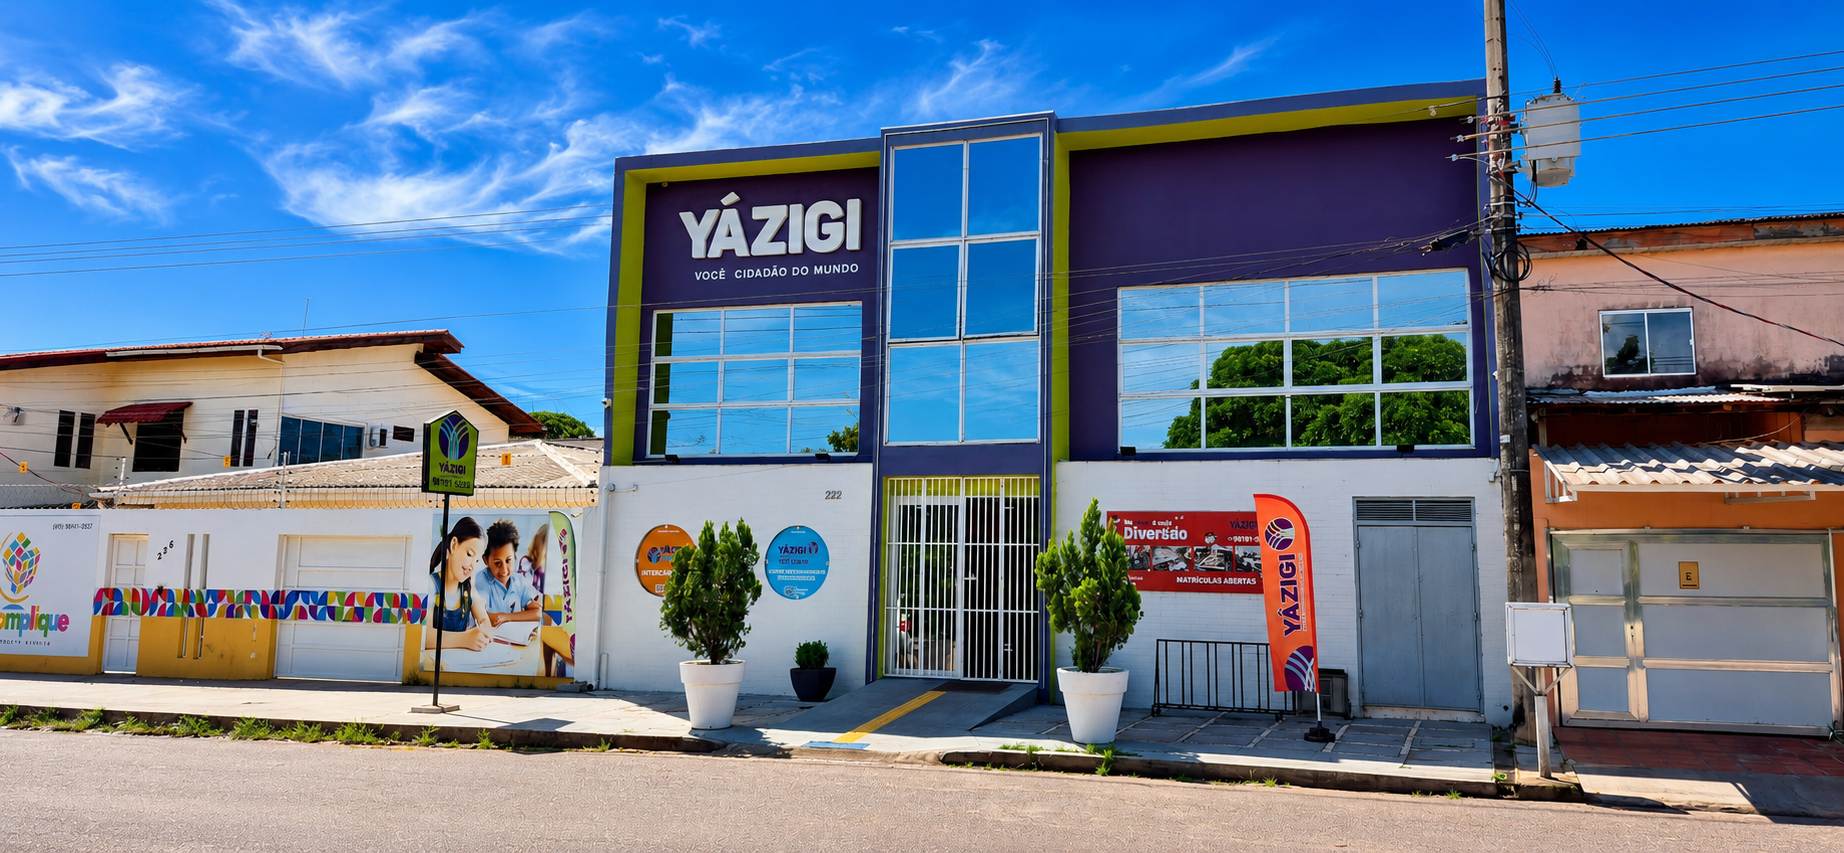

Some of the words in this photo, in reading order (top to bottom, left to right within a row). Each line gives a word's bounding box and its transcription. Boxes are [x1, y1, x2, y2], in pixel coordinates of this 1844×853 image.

[678, 191, 862, 259] YÁZIGI
[695, 267, 726, 281] VOCÊ
[734, 264, 788, 279] CIDADÃO
[791, 266, 809, 276] DO
[813, 263, 859, 275] MUNDO
[439, 461, 466, 475] YÁZIGI
[825, 490, 842, 500] 222
[157, 540, 174, 561] 236
[778, 544, 807, 555] YÁZIGI
[1223, 577, 1257, 585] ABERTAS
